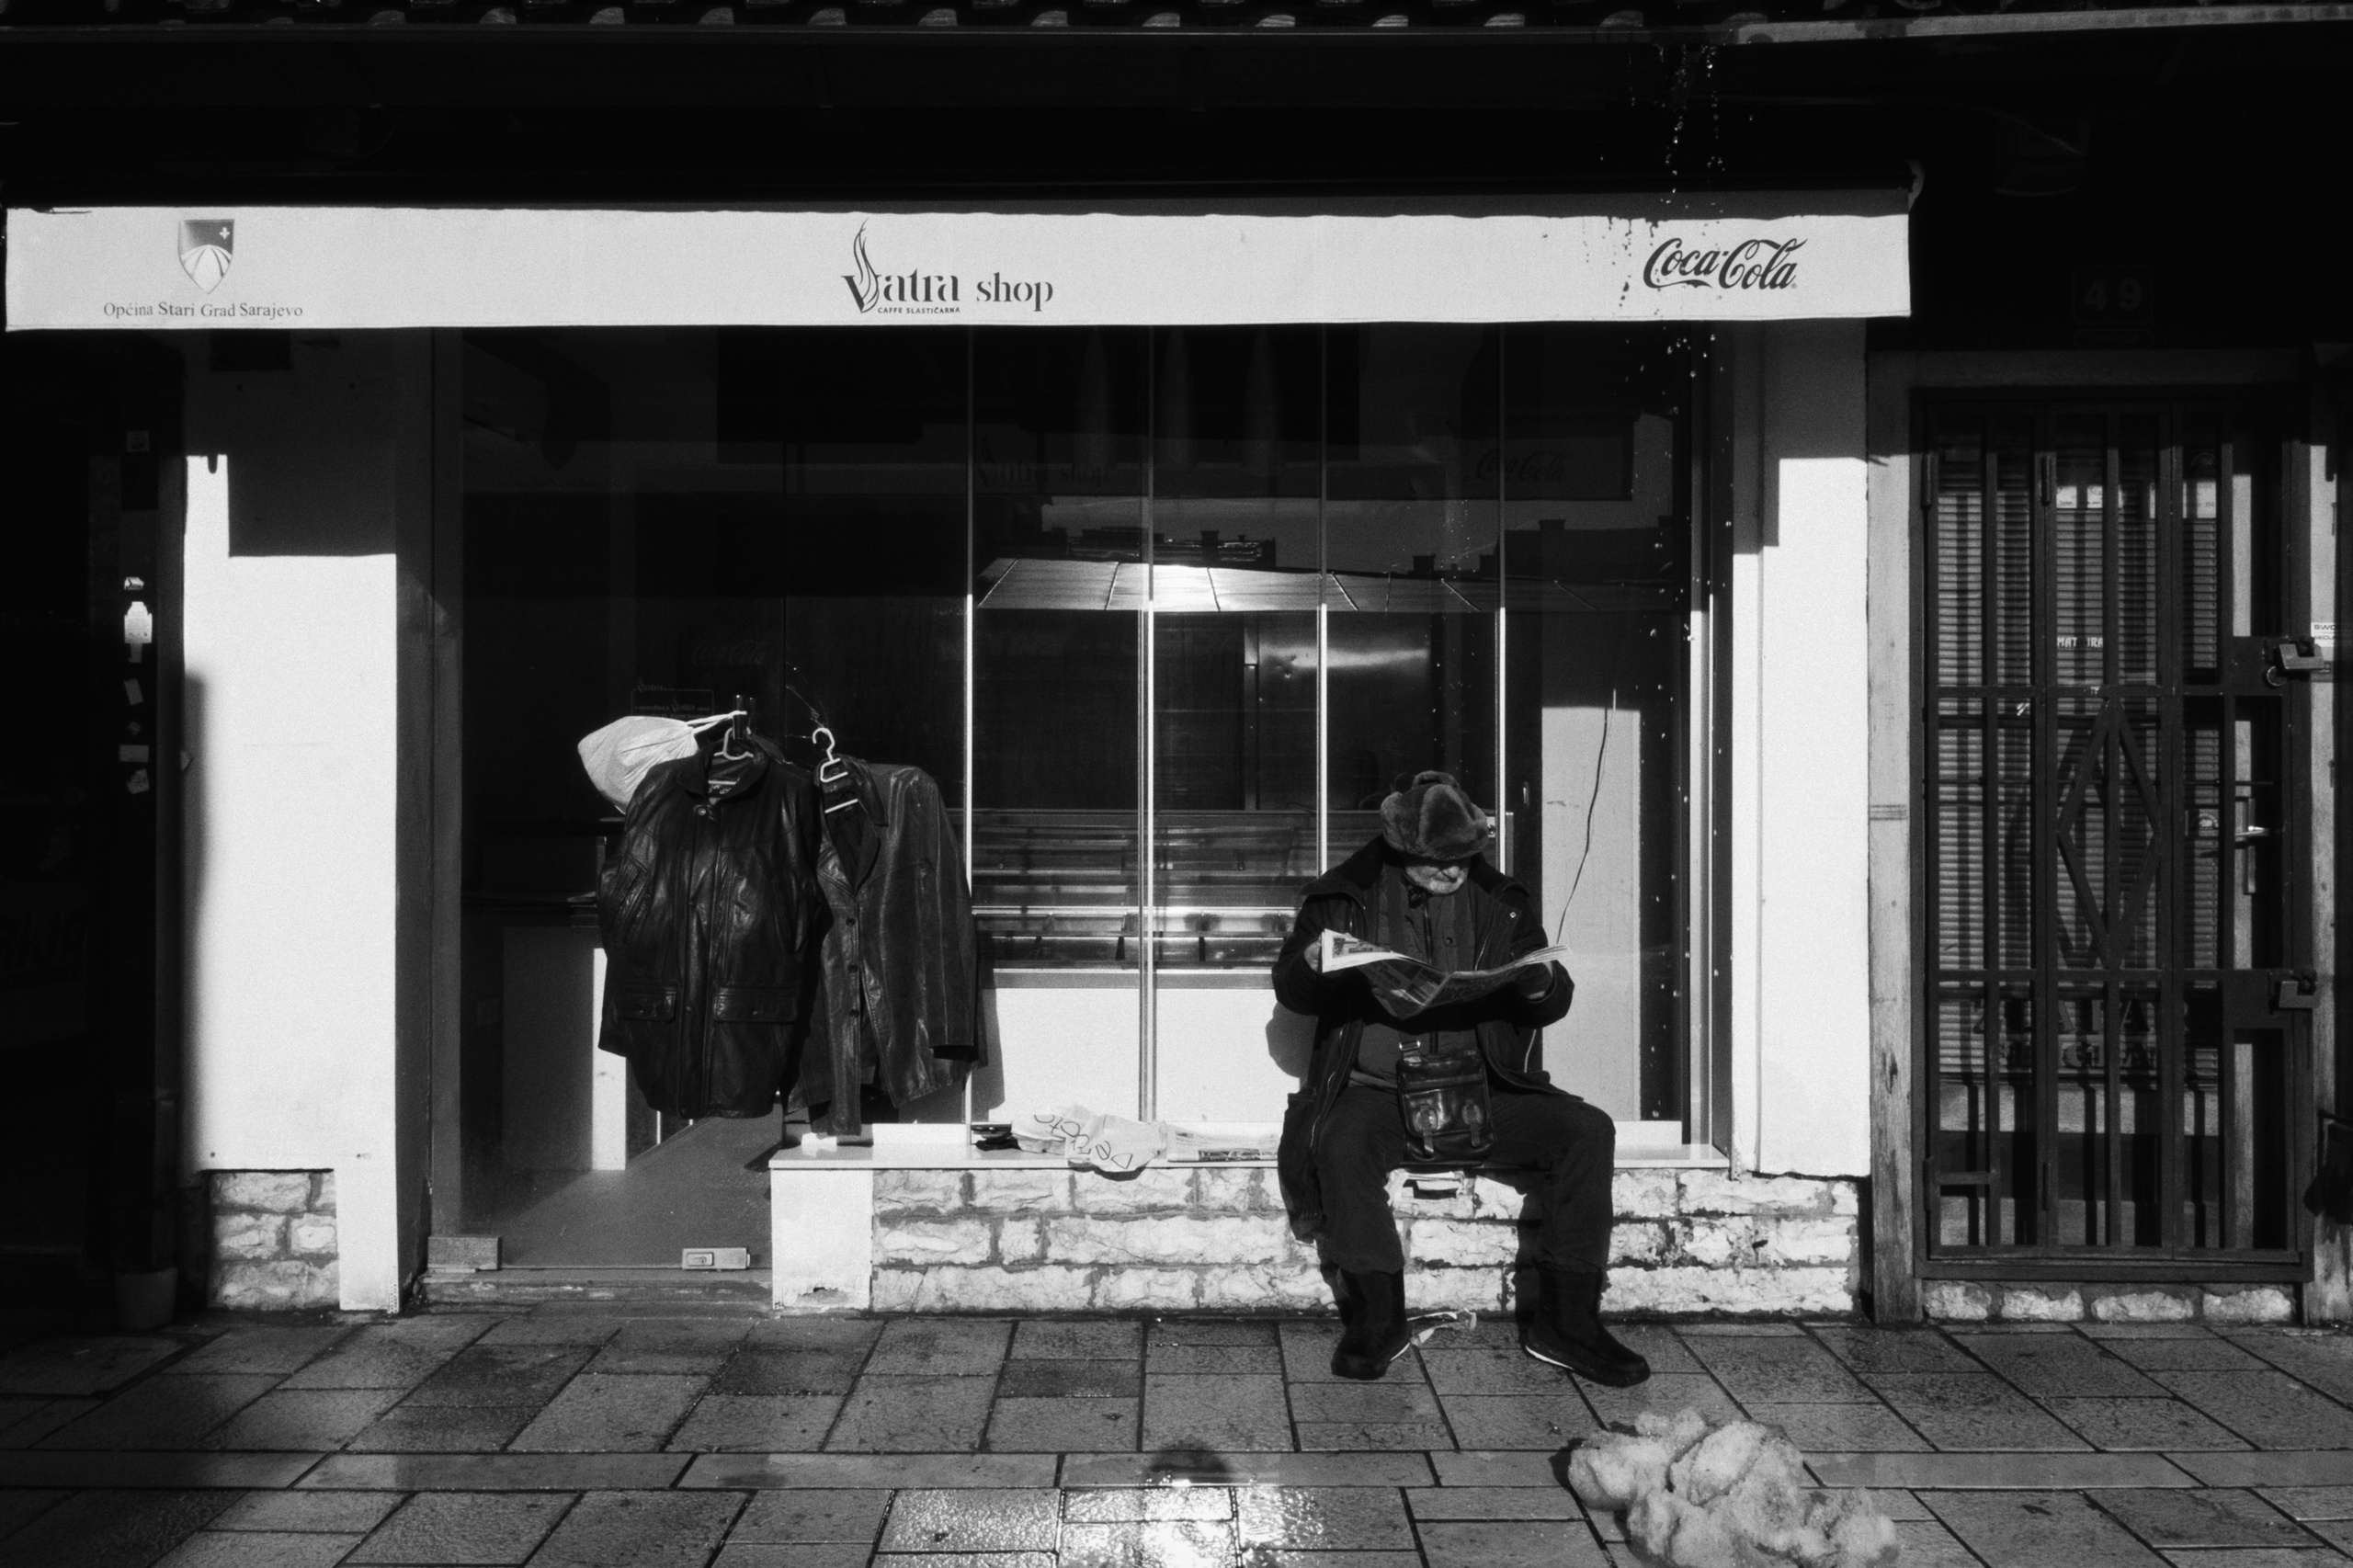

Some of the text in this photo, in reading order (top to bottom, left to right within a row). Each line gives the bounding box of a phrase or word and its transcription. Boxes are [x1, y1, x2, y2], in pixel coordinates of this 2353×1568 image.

[840, 217, 1053, 313] Vatra shop
[1643, 237, 1808, 290] Coca-Cola
[104, 301, 303, 320] Općina Stari Grad Sarajevo
[2083, 278, 2143, 312] 49
